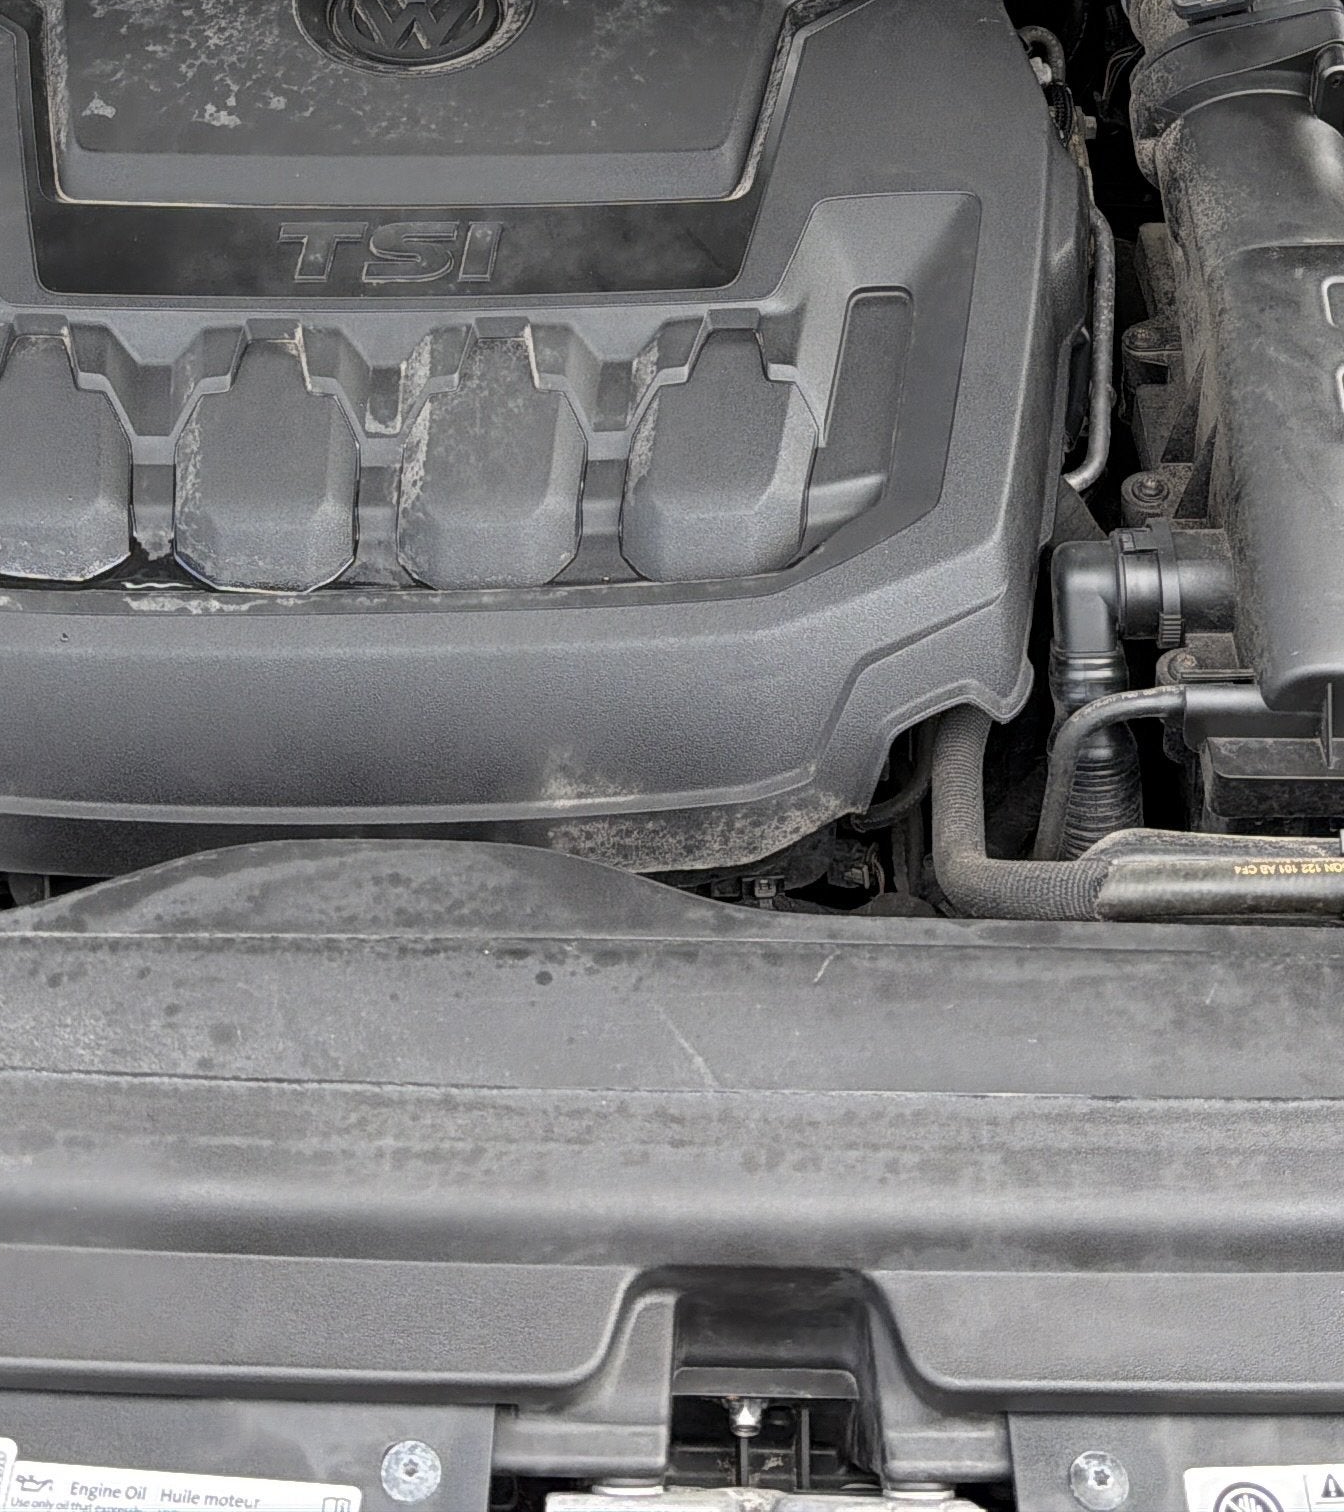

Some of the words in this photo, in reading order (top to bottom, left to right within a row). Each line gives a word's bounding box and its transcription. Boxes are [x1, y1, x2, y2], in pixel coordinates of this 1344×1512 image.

[278, 220, 504, 284] TSI
[1278, 863, 1298, 874] 101
[1301, 863, 1322, 873] 122
[69, 1481, 121, 1503] Engine
[124, 1485, 147, 1501] Oil
[159, 1487, 200, 1505] Huile
[204, 1493, 261, 1509] moteur
[10, 1496, 30, 1508] Use
[30, 1499, 55, 1512] only
